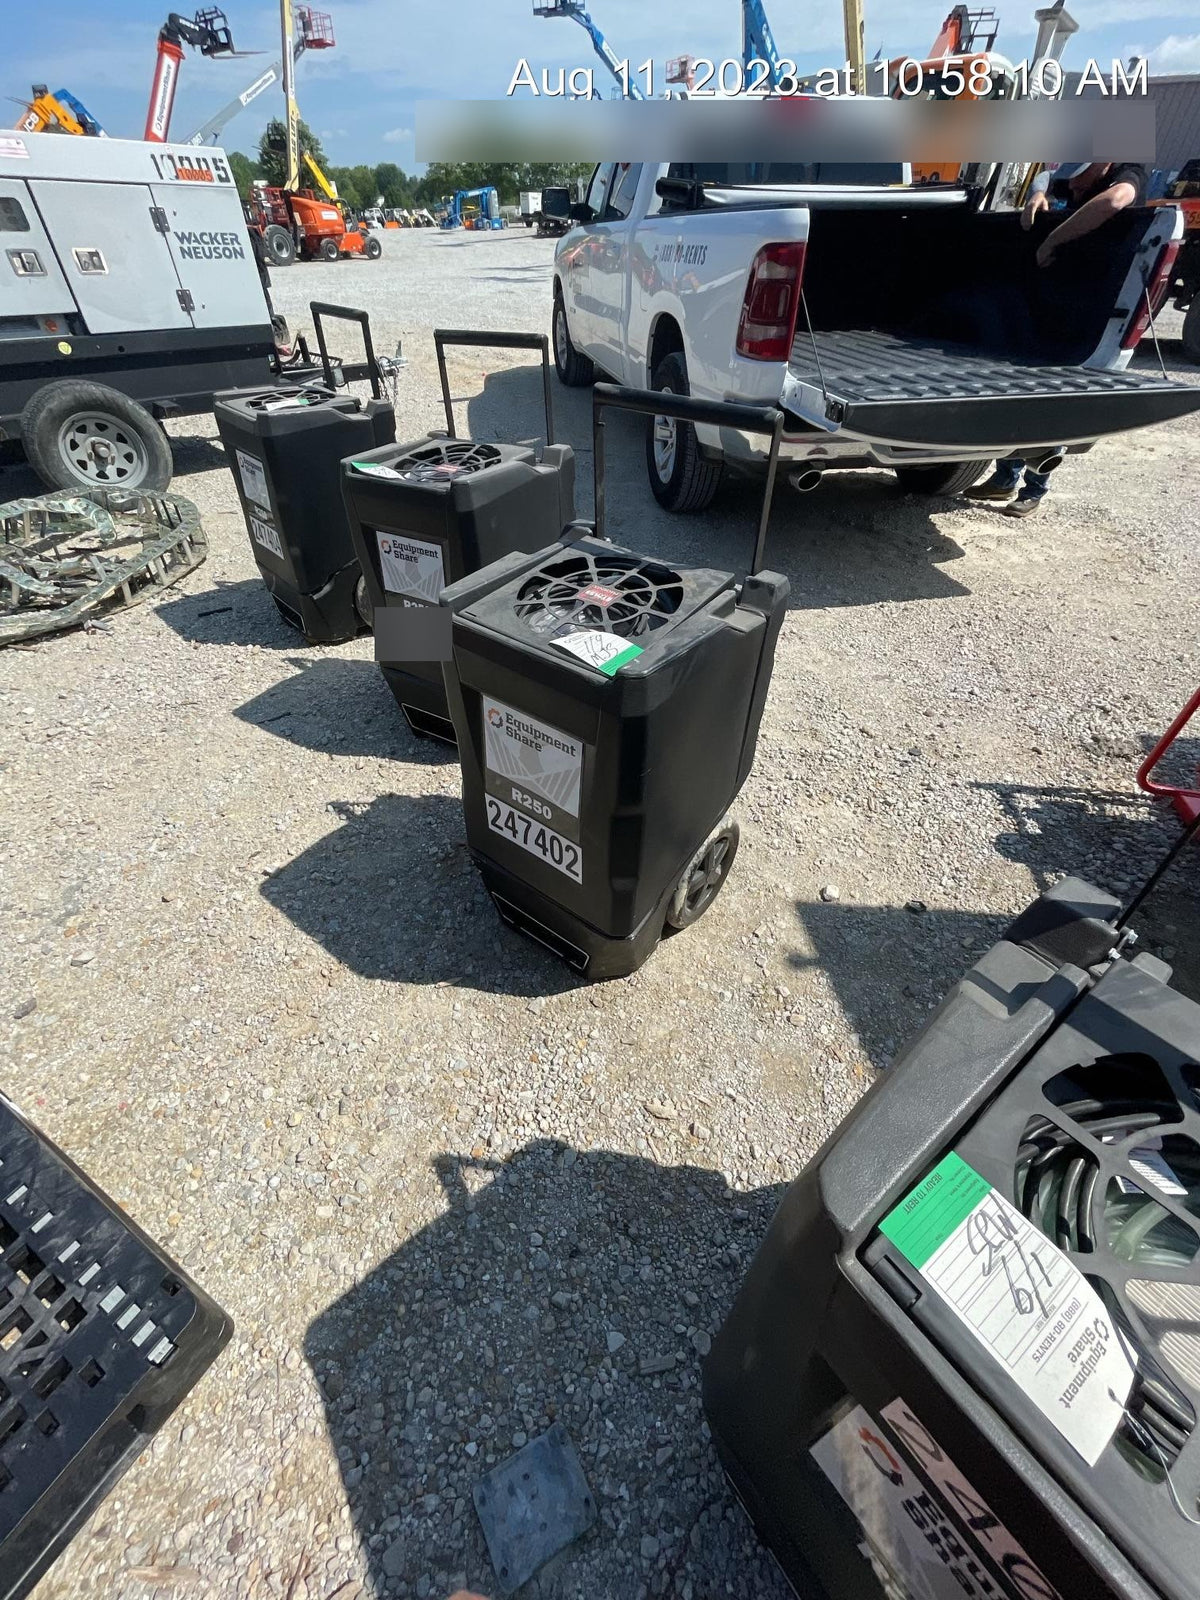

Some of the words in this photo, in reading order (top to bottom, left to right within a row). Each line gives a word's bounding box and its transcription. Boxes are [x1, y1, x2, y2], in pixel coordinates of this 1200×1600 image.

[174, 231, 242, 246] WACKER
[181, 246, 245, 260] NEUSON
[392, 540, 438, 558] Equipment
[394, 549, 418, 563] Share
[505, 712, 576, 757] Equipment
[506, 726, 542, 751] Share
[512, 787, 552, 820] R250
[488, 800, 580, 878] 247402
[916, 1189, 926, 1200] TO
[923, 1172, 943, 1193] READY
[902, 1196, 919, 1215] RENT
[1061, 1298, 1081, 1323] (888)
[1031, 1320, 1066, 1363] 80-RENTS
[1067, 1328, 1096, 1363] Share
[1058, 1341, 1108, 1408] Equipment
